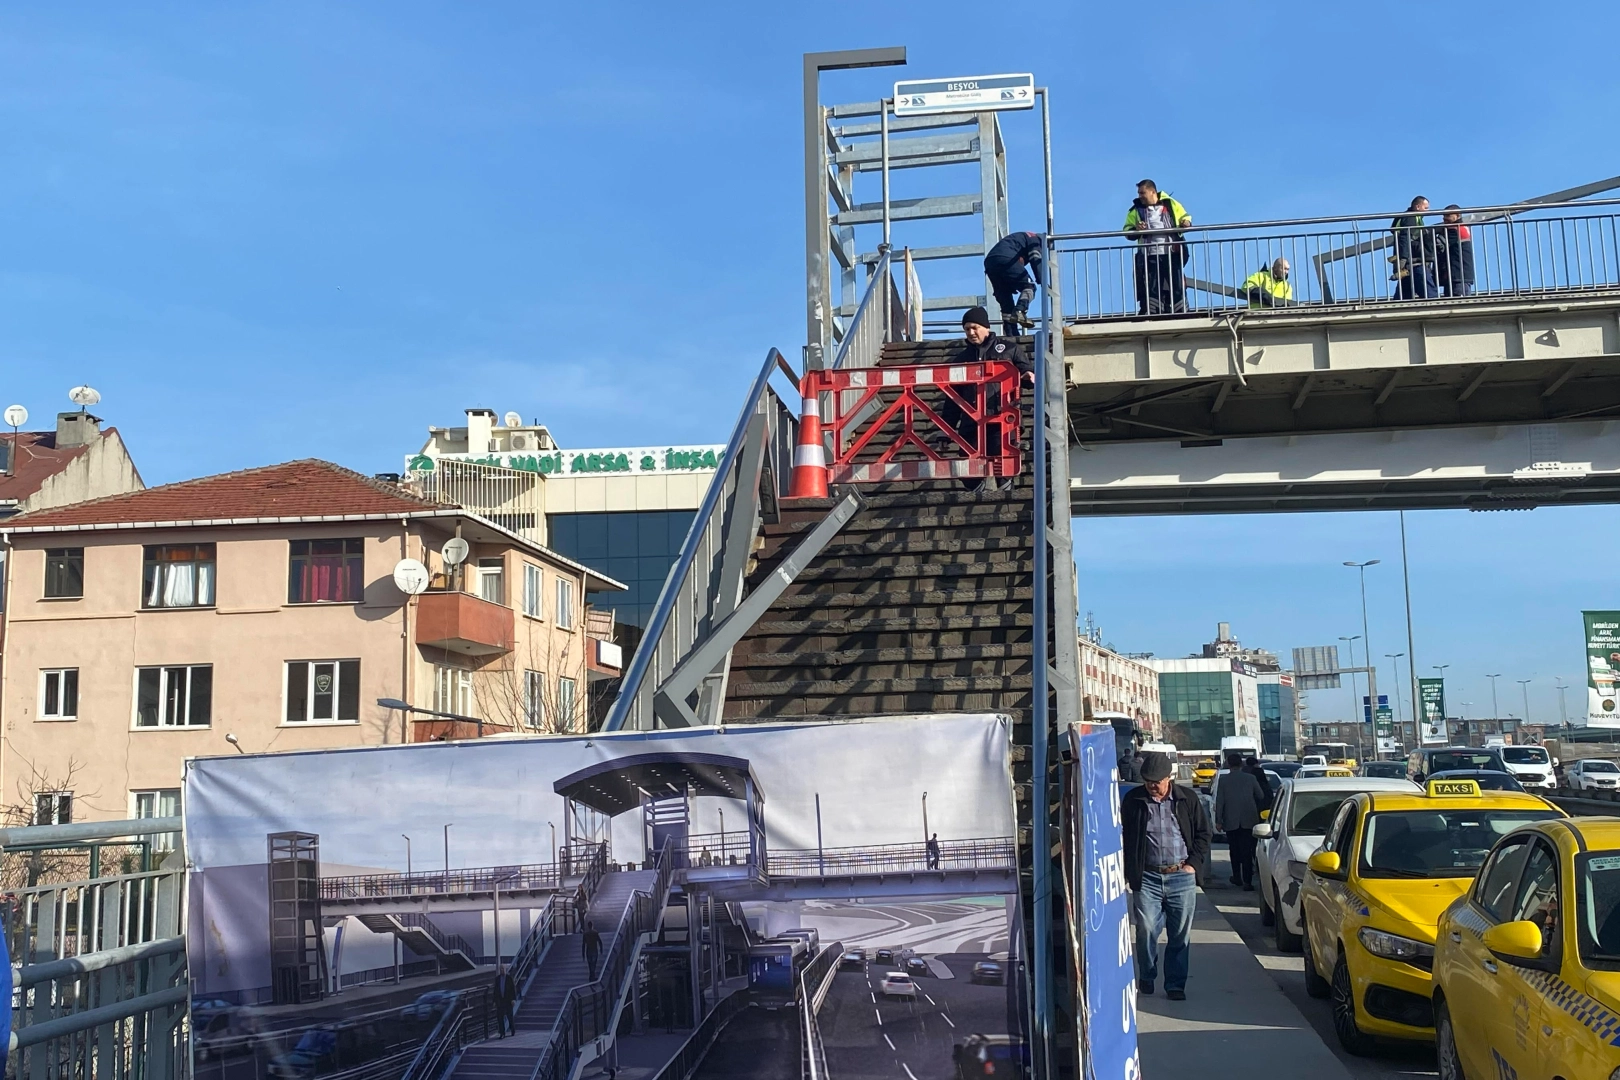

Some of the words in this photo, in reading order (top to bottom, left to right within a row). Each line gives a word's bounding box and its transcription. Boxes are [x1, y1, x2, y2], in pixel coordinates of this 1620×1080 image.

[947, 82, 980, 92] BEŞYOL
[570, 452, 630, 474] ARSA
[640, 455, 656, 471] &
